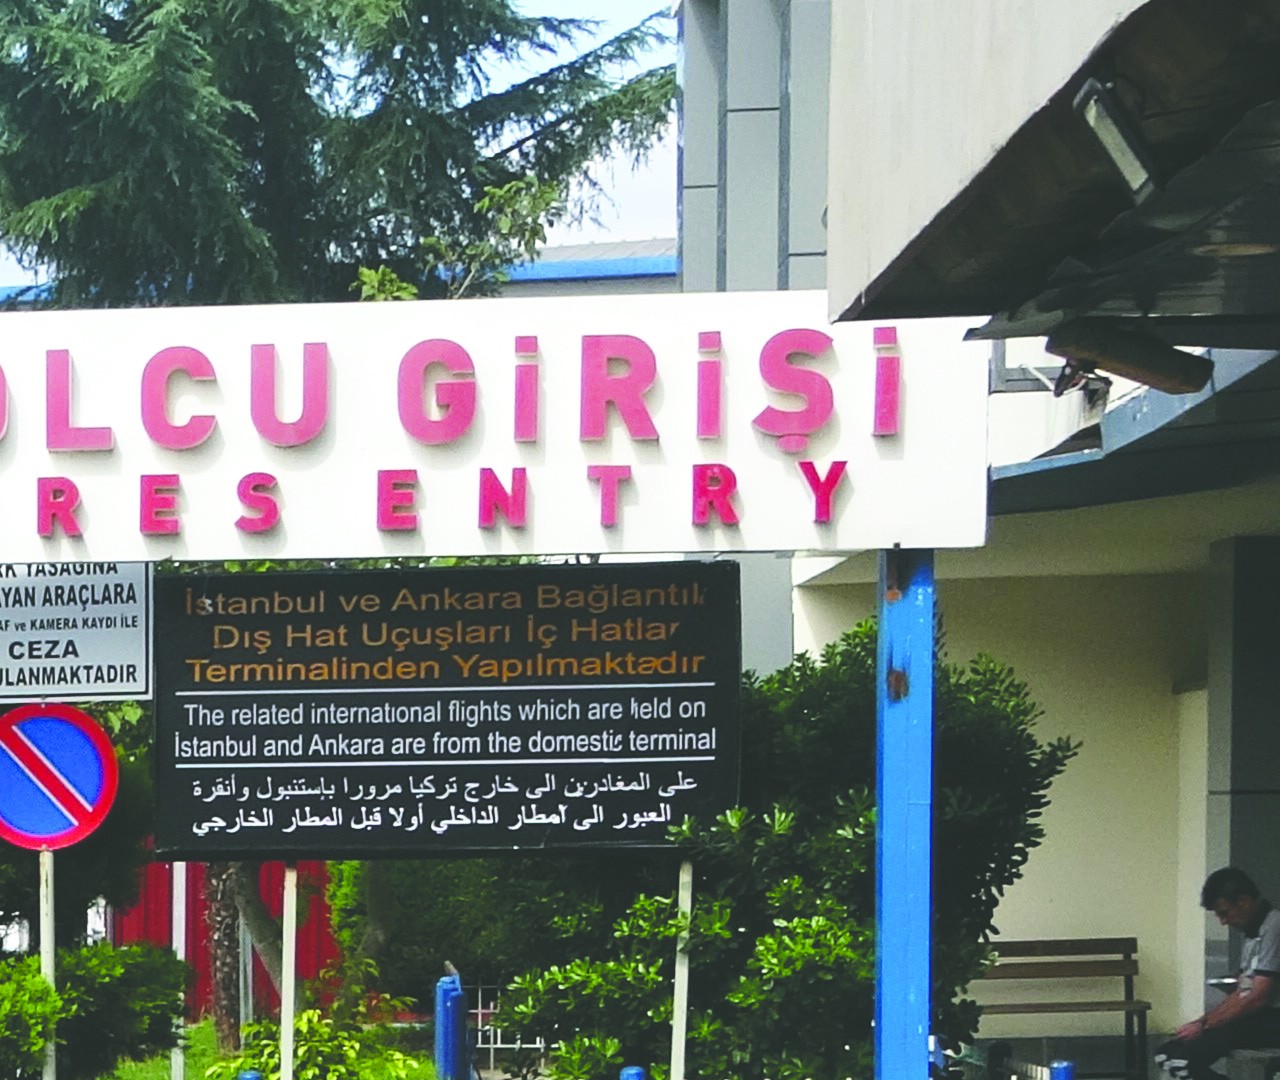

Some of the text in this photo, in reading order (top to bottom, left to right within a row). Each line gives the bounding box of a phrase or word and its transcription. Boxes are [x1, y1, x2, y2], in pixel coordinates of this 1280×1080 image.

[378, 461, 849, 531] ENTRY
[42, 582, 138, 612] ARAÇLARA
[185, 588, 325, 615] İstanbul
[339, 594, 380, 612] ve
[391, 587, 522, 611] Ankara
[15, 622, 27, 631] ve
[30, 618, 78, 631] KAMERA
[82, 616, 117, 629] KAYDI
[121, 613, 138, 628] İLE
[213, 614, 680, 654] Dış Hat Uçuşları İç Hatlar
[9, 639, 80, 660] CEZA
[185, 650, 706, 683] Terminalinden Yapılmaktadır
[184, 703, 224, 726] The
[231, 703, 303, 726] related
[449, 700, 512, 727] flights
[518, 698, 580, 721] which
[588, 702, 623, 720] are
[630, 697, 672, 720] held
[679, 701, 706, 718] on
[175, 727, 716, 757] İstanbul and Ankara are from the domestic terminal
[343, 776, 402, 801] مرورا
[408, 775, 458, 800] تركيا
[464, 775, 519, 802] خارج
[658, 771, 698, 796] على
[192, 808, 274, 836] الخارجي
[282, 807, 343, 833] المطار
[350, 806, 382, 831] قبل
[389, 803, 424, 831] أولا
[431, 804, 499, 834] الداخلي
[613, 803, 672, 829] العبور
